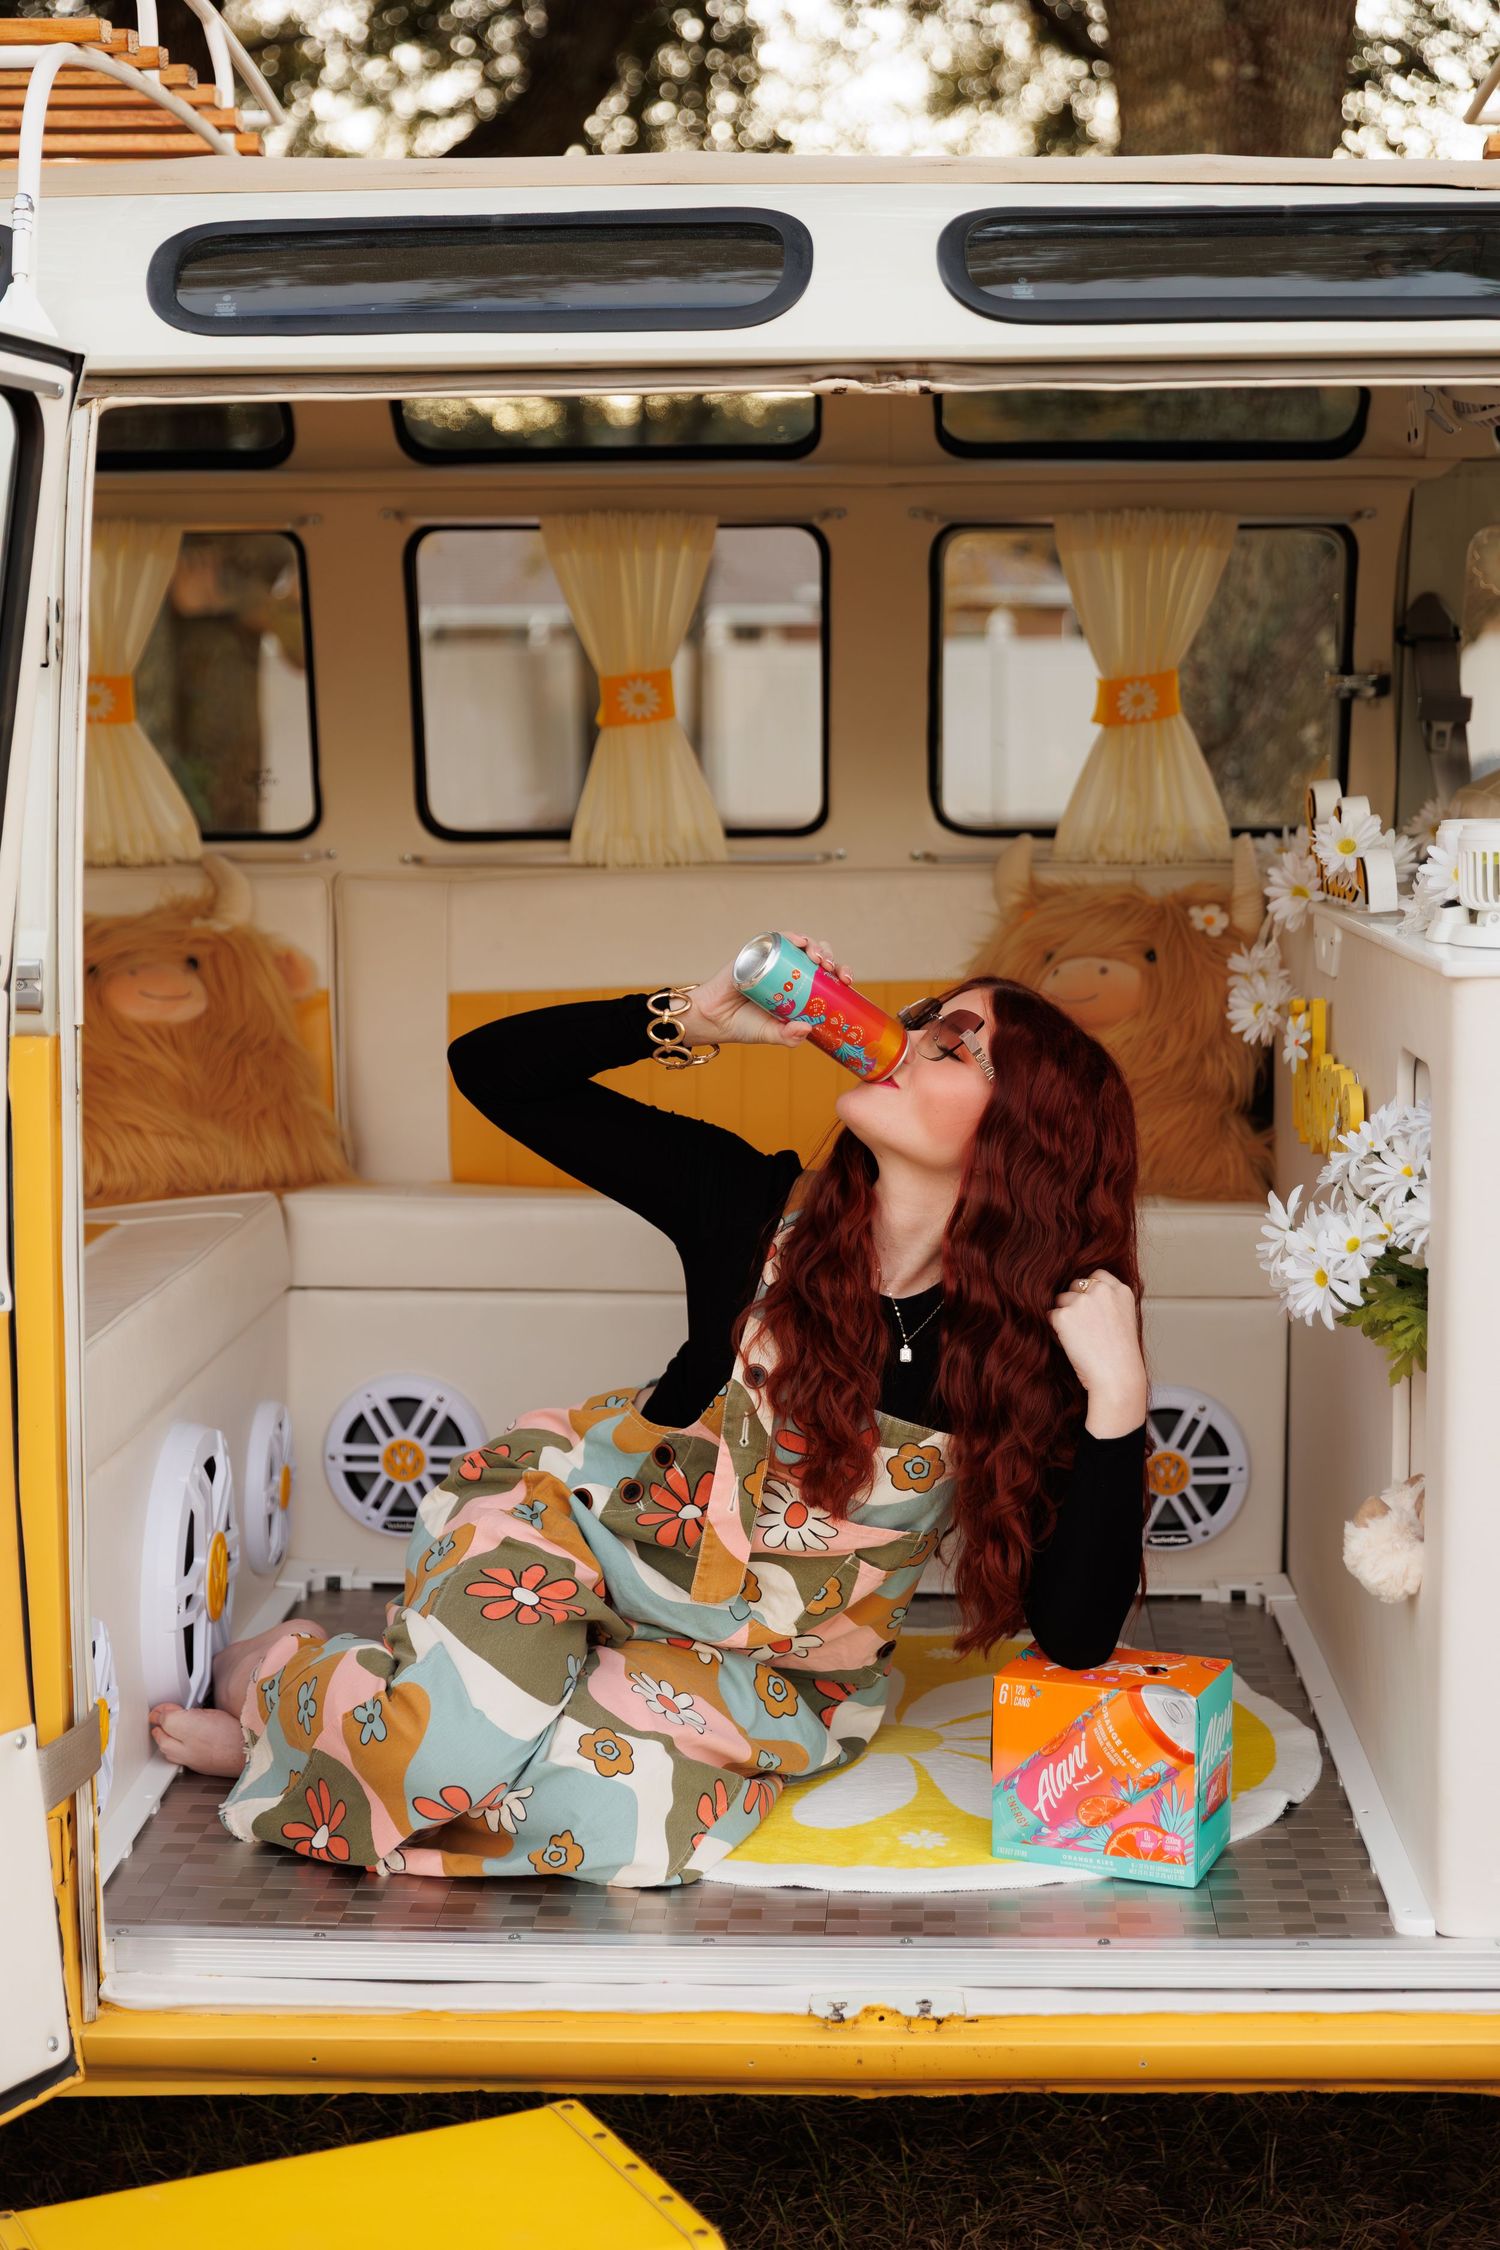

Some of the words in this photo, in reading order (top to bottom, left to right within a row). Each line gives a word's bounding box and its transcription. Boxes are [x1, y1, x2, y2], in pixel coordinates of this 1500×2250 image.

[999, 1683, 1009, 1704] 6
[1013, 1697, 1031, 1708] CANS
[1102, 1705, 1123, 1747] ORANGE
[1121, 1748, 1142, 1769] KISS
[1033, 1732, 1088, 1822] Alani
[1007, 1795, 1031, 1828] ENERGY
